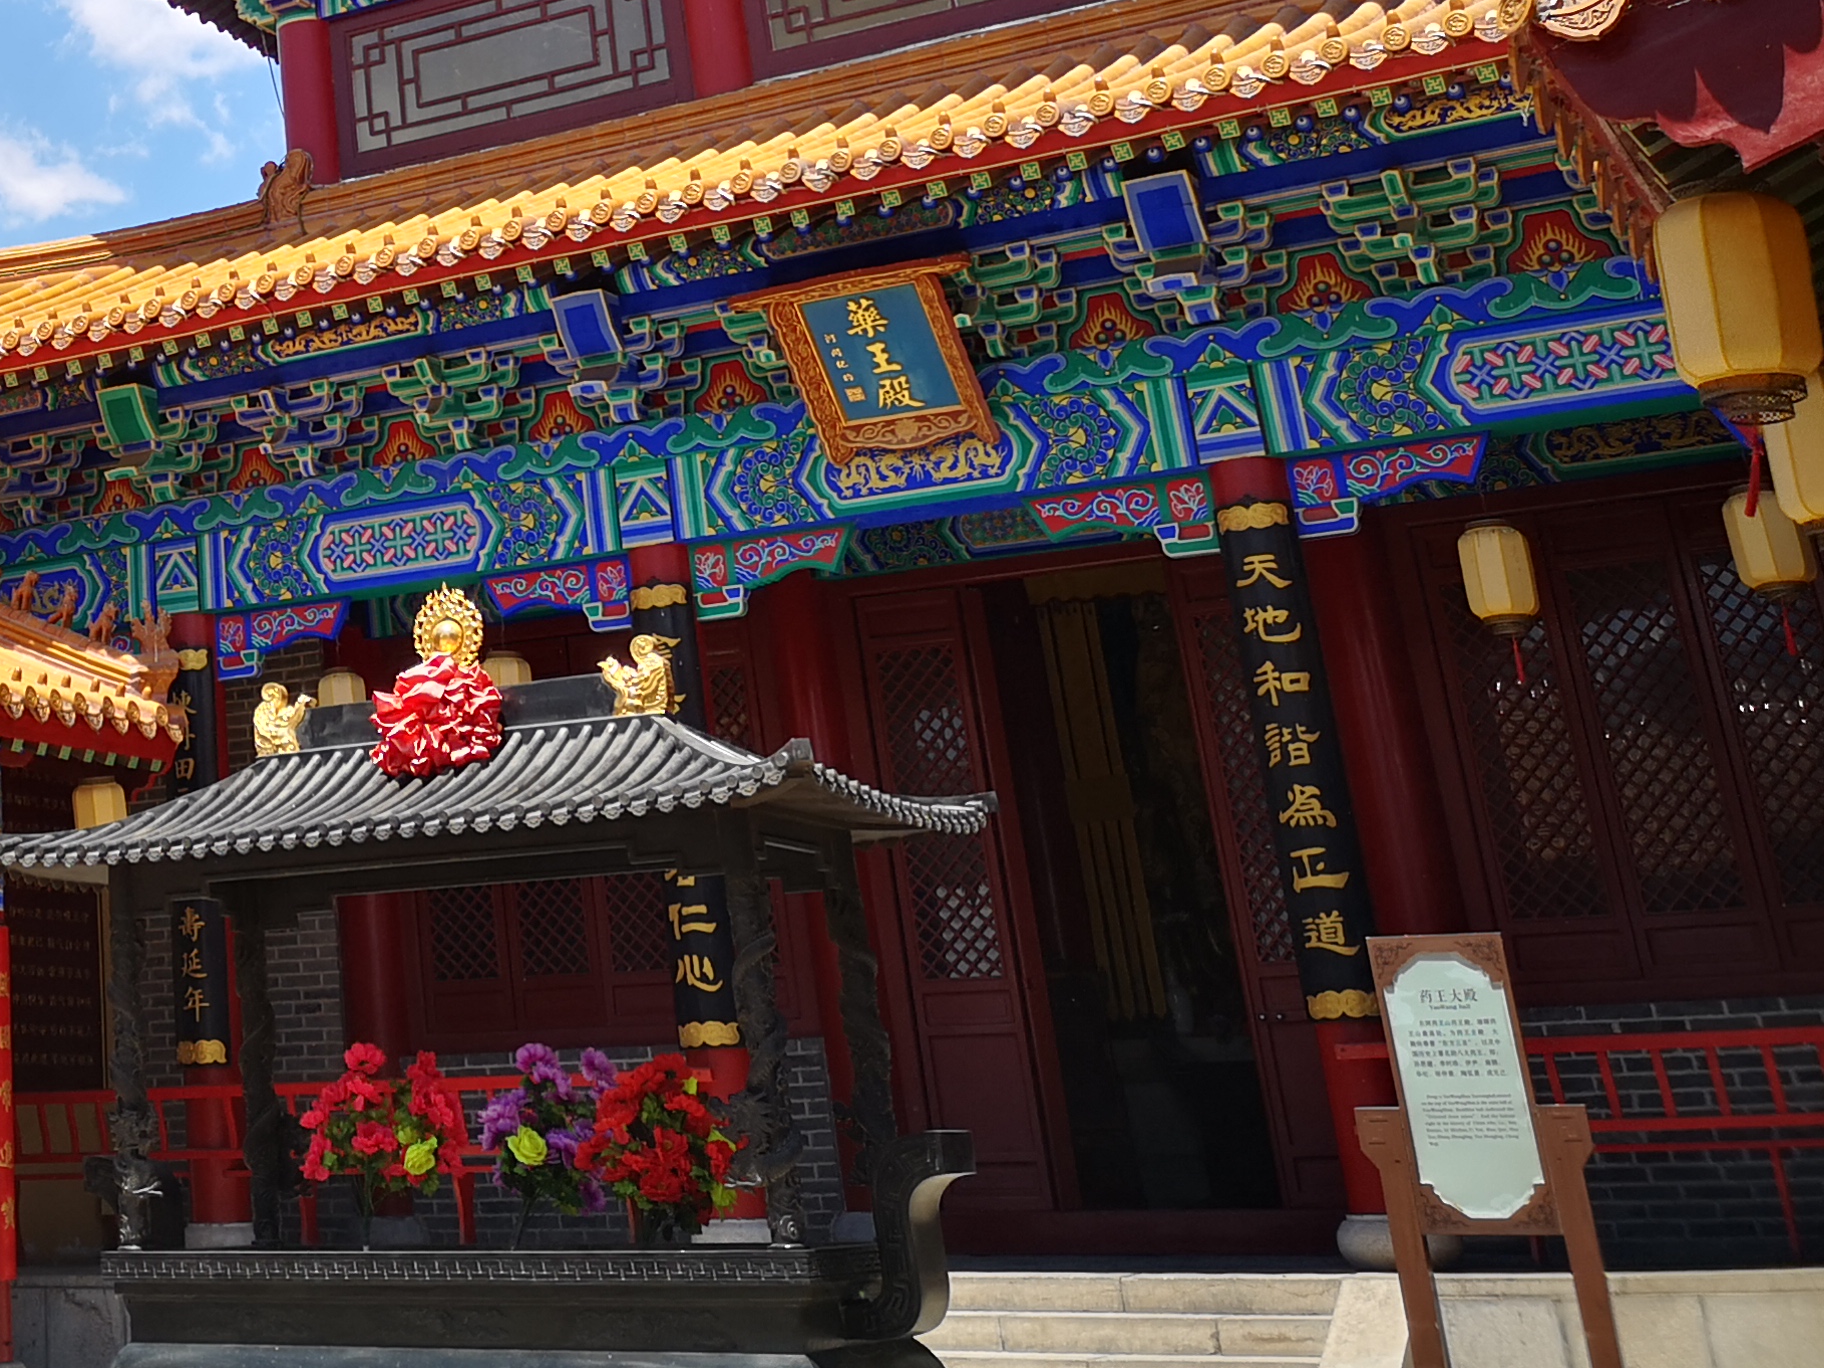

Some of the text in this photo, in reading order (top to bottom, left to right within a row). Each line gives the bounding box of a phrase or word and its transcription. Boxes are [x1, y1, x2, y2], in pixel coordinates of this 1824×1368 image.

[844, 297, 927, 411] 藥王殿
[177, 906, 211, 1023] 壽延年
[664, 869, 724, 993] 仁心
[1419, 988, 1479, 1003] 药王大殿
